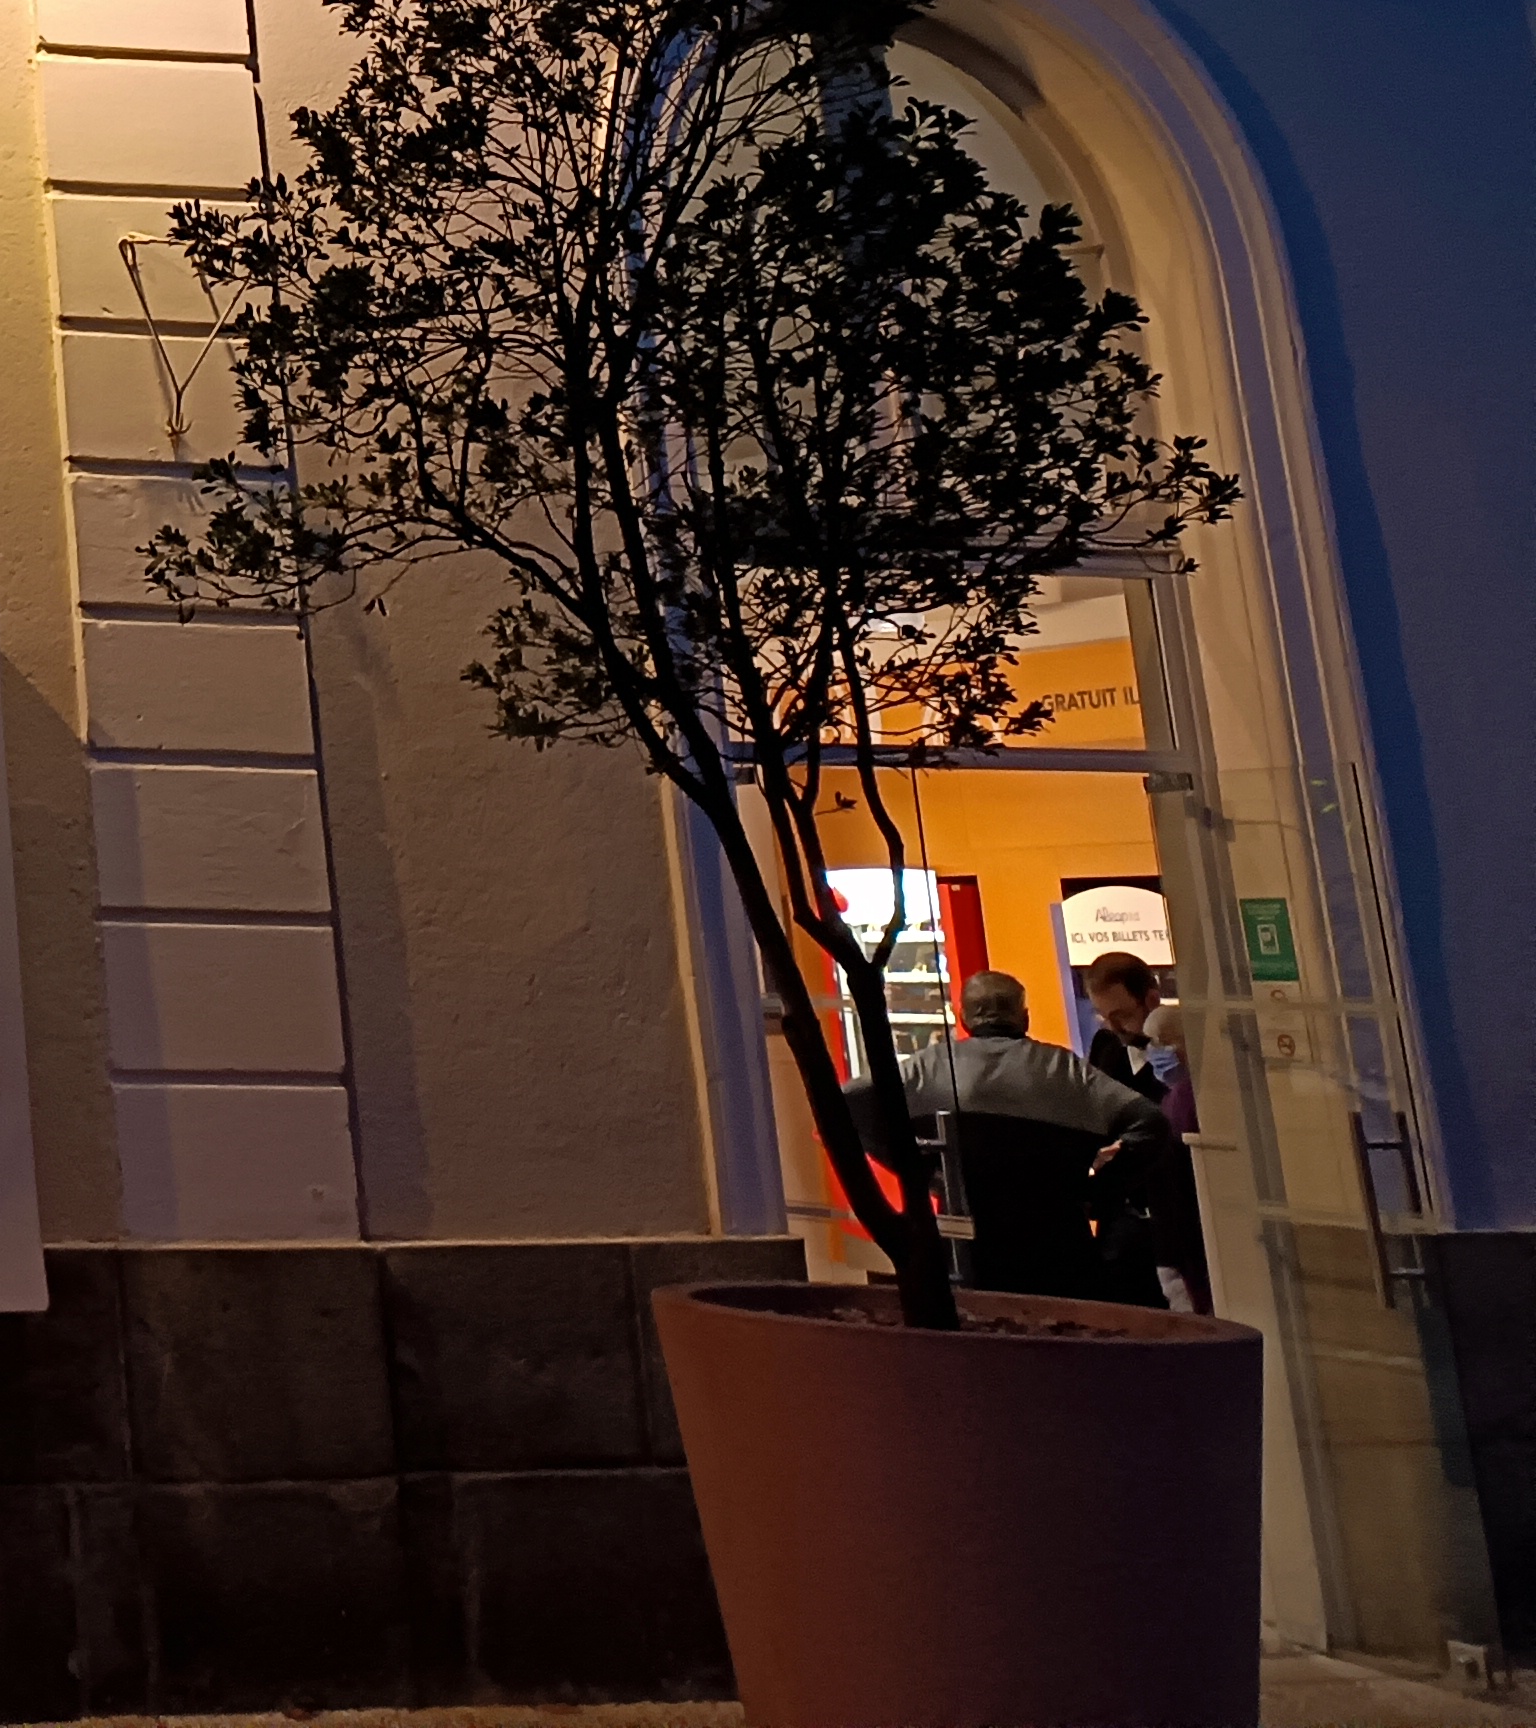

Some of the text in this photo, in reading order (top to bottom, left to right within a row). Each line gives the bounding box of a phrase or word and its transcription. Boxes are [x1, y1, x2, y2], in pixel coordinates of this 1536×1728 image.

[1042, 687, 1116, 712] GRATUIT
[1088, 931, 1109, 943] VOS
[1112, 930, 1150, 942] BILLETS
